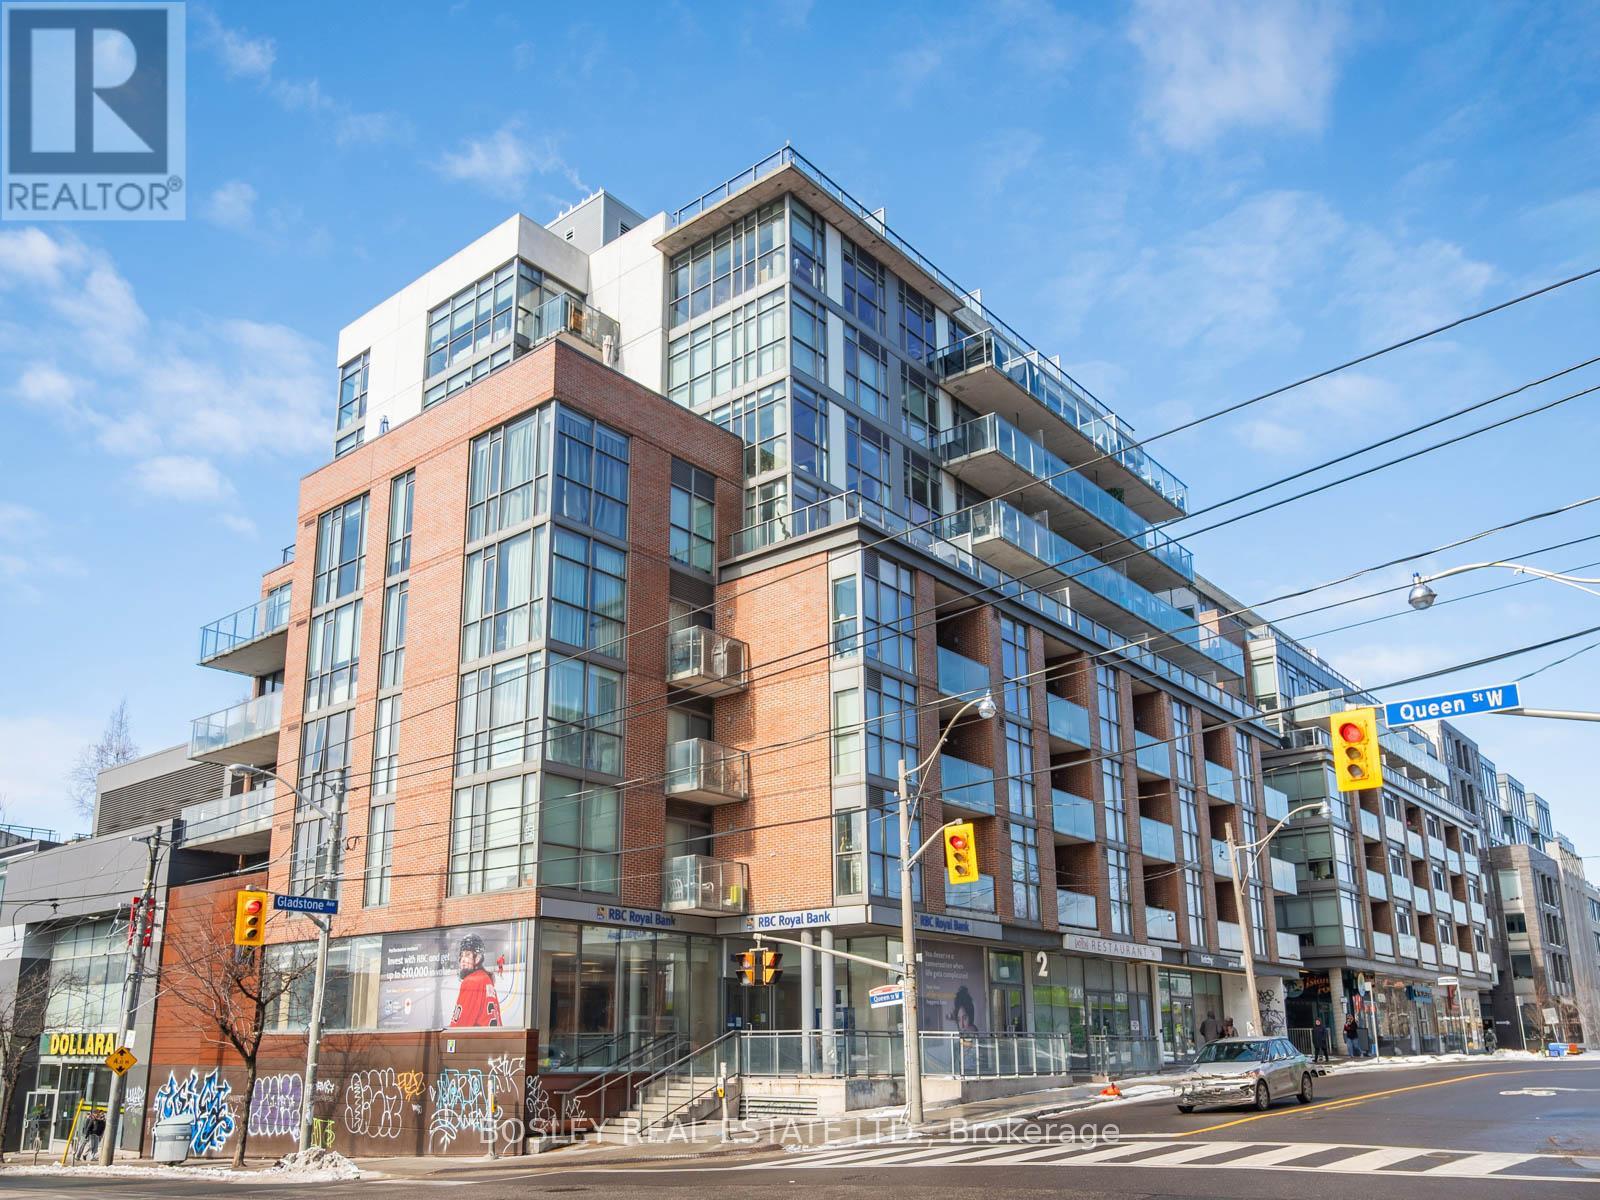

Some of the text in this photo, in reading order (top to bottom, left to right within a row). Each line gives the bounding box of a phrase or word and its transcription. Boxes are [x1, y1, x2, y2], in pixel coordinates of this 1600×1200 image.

[1400, 689, 1503, 721] Queen St W
[277, 896, 324, 910] Gladstone
[608, 908, 677, 926] RBC Royal Bank
[758, 911, 831, 928] RBC Royal Bank
[920, 915, 969, 932] RBC Royal Bank
[1091, 941, 1147, 957] RESTAURANT
[388, 957, 403, 965] Invest
[404, 955, 415, 964] with
[416, 954, 428, 963] RBC
[429, 953, 440, 962] and
[1036, 951, 1048, 977] 2
[387, 973, 393, 982] up
[394, 971, 401, 979] to
[402, 966, 428, 979] $10,000
[873, 994, 890, 1003] Queen
[50, 1033, 115, 1056] DOLLARA
